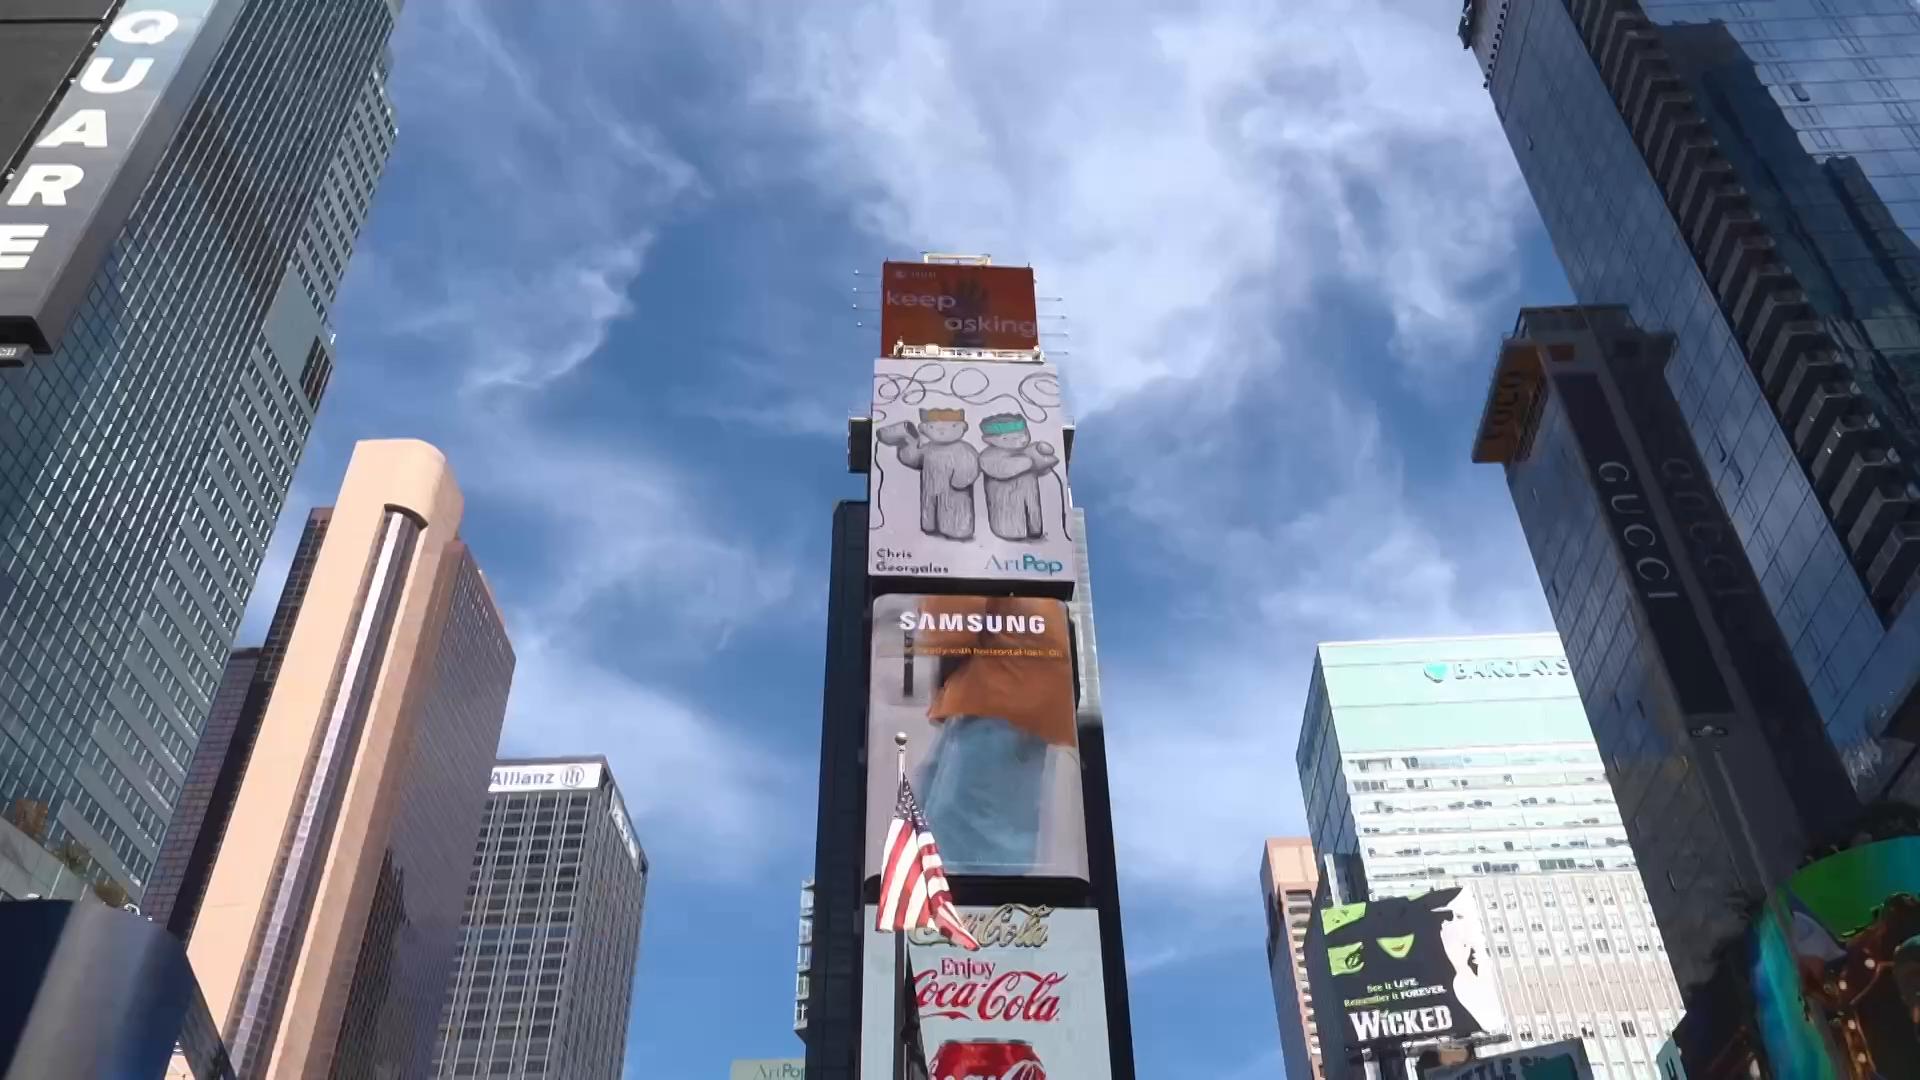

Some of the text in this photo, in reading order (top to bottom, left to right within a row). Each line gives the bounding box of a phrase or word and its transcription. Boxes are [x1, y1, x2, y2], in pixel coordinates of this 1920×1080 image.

[886, 291, 956, 312] keep
[944, 316, 1037, 337] asking
[1599, 461, 1679, 598] GUCCI
[876, 548, 912, 559] Chris
[876, 561, 949, 574] Georgalas
[984, 553, 1063, 576] ArtPop
[900, 611, 1046, 634] SAMSUNG
[1452, 659, 1569, 680] BARCLAYS
[490, 771, 556, 786] Allianz
[941, 957, 996, 980] Enjoy
[1343, 995, 1390, 1007] Rember
